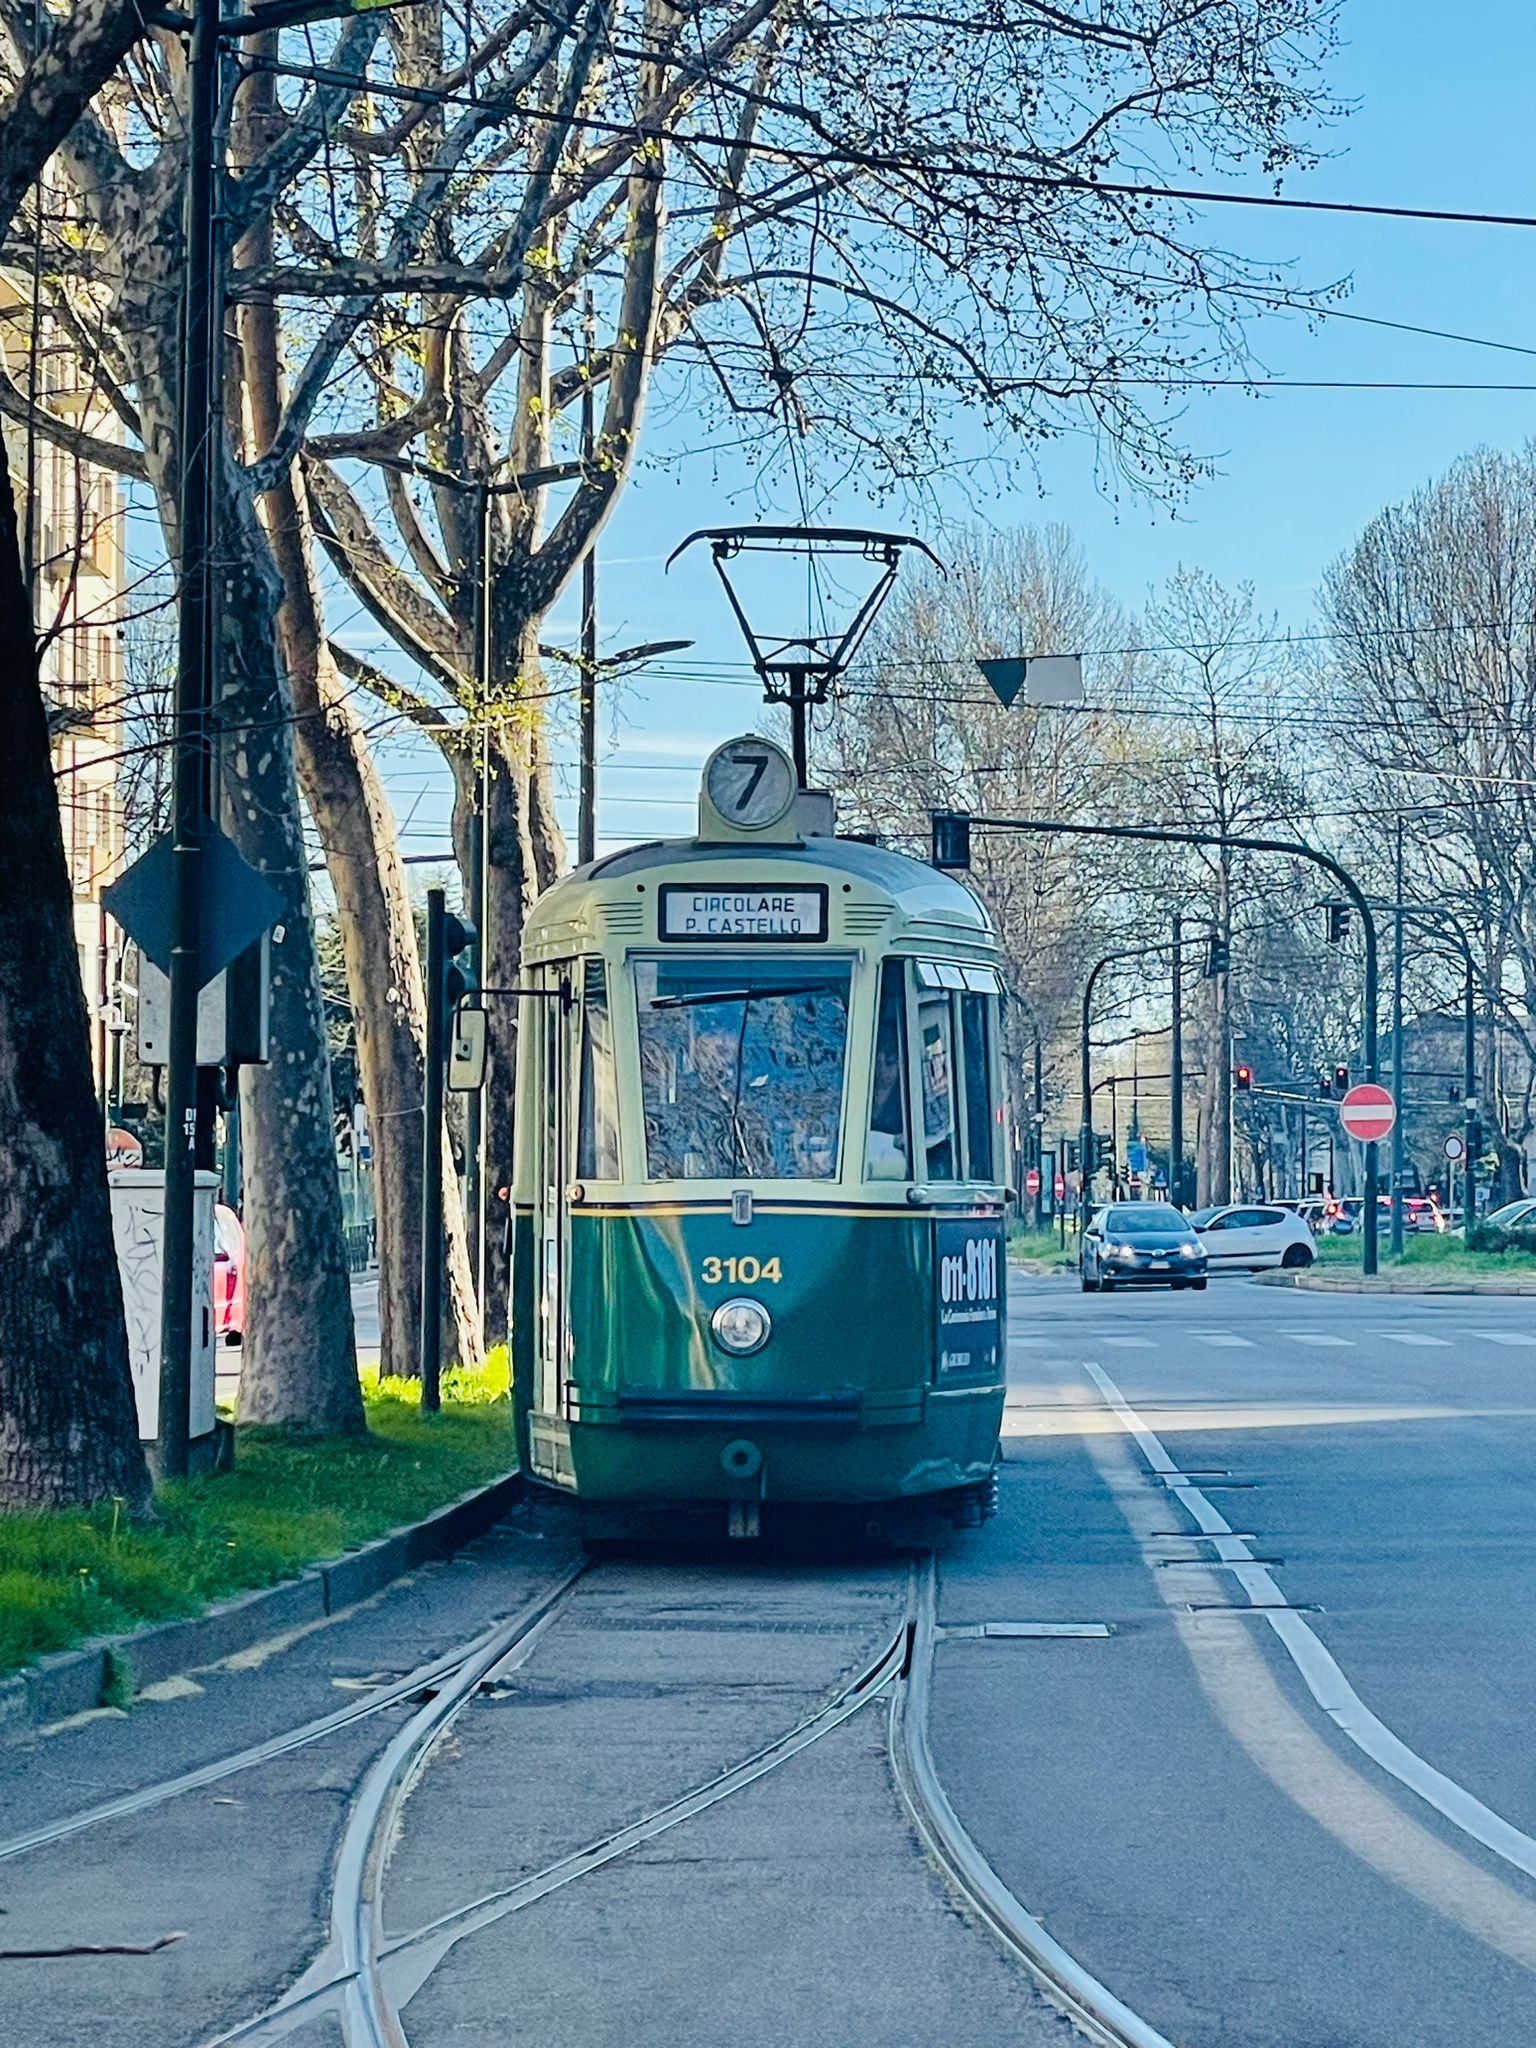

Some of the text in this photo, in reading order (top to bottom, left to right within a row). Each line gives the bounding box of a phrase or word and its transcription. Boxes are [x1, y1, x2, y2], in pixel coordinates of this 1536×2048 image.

[732, 755, 769, 811] 7
[692, 897, 796, 913] CIRCOLARE
[686, 918, 801, 934] P. CASTELLO
[701, 1256, 783, 1284] 3104
